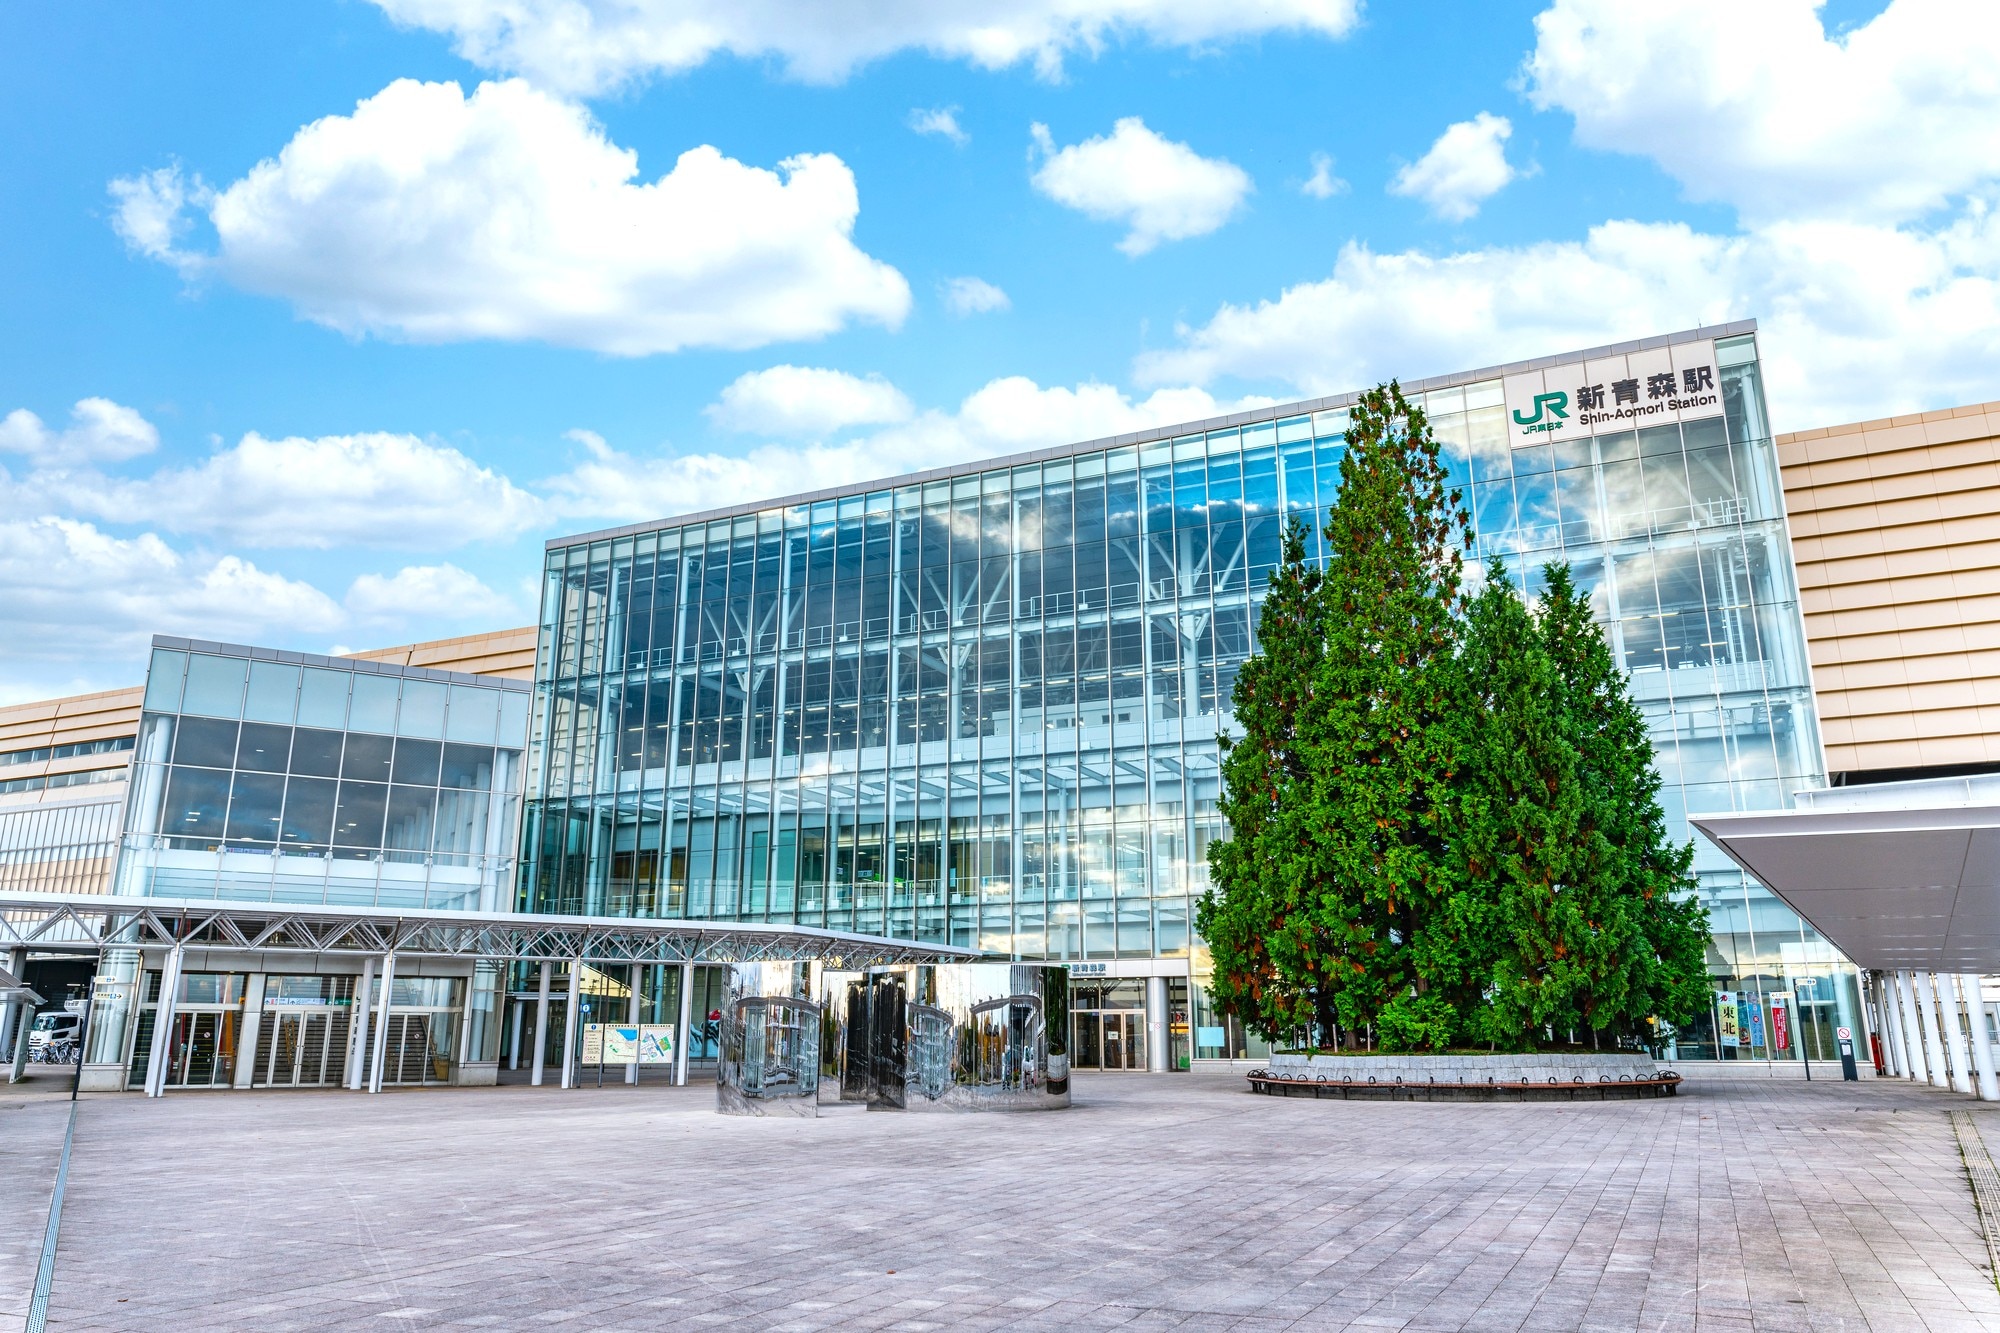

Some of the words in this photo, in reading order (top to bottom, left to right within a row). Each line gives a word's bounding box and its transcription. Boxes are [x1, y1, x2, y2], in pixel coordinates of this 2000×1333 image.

[1577, 365, 1714, 412] 新青森駅
[1513, 391, 1570, 425] JR
[1579, 404, 1664, 426] Shin-Aomori
[1668, 394, 1717, 411] Station
[1522, 421, 1564, 435] JR東日本
[1722, 1006, 1735, 1034] 東北
